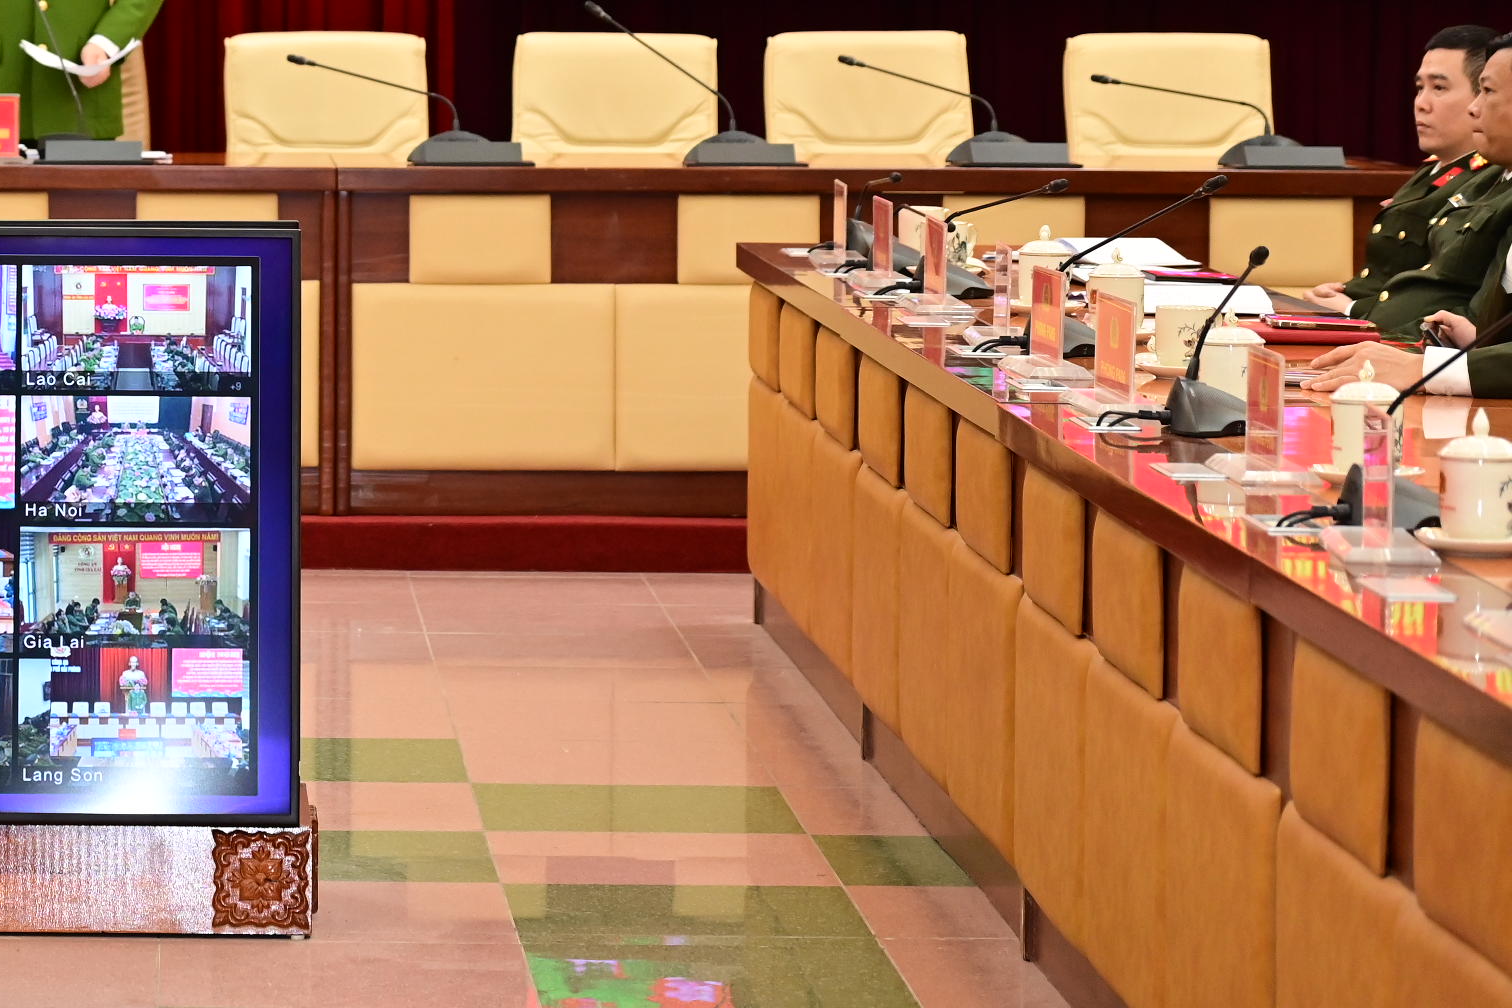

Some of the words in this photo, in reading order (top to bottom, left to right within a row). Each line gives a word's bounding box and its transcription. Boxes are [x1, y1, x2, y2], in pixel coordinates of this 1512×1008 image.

[26, 372, 56, 386] Lao
[63, 372, 91, 386] Cai
[25, 504, 47, 517] Ha
[55, 503, 82, 517] Noi
[23, 635, 51, 649] Gia
[60, 635, 84, 649] Lai
[22, 768, 62, 784] Lang
[70, 768, 102, 781] Son
